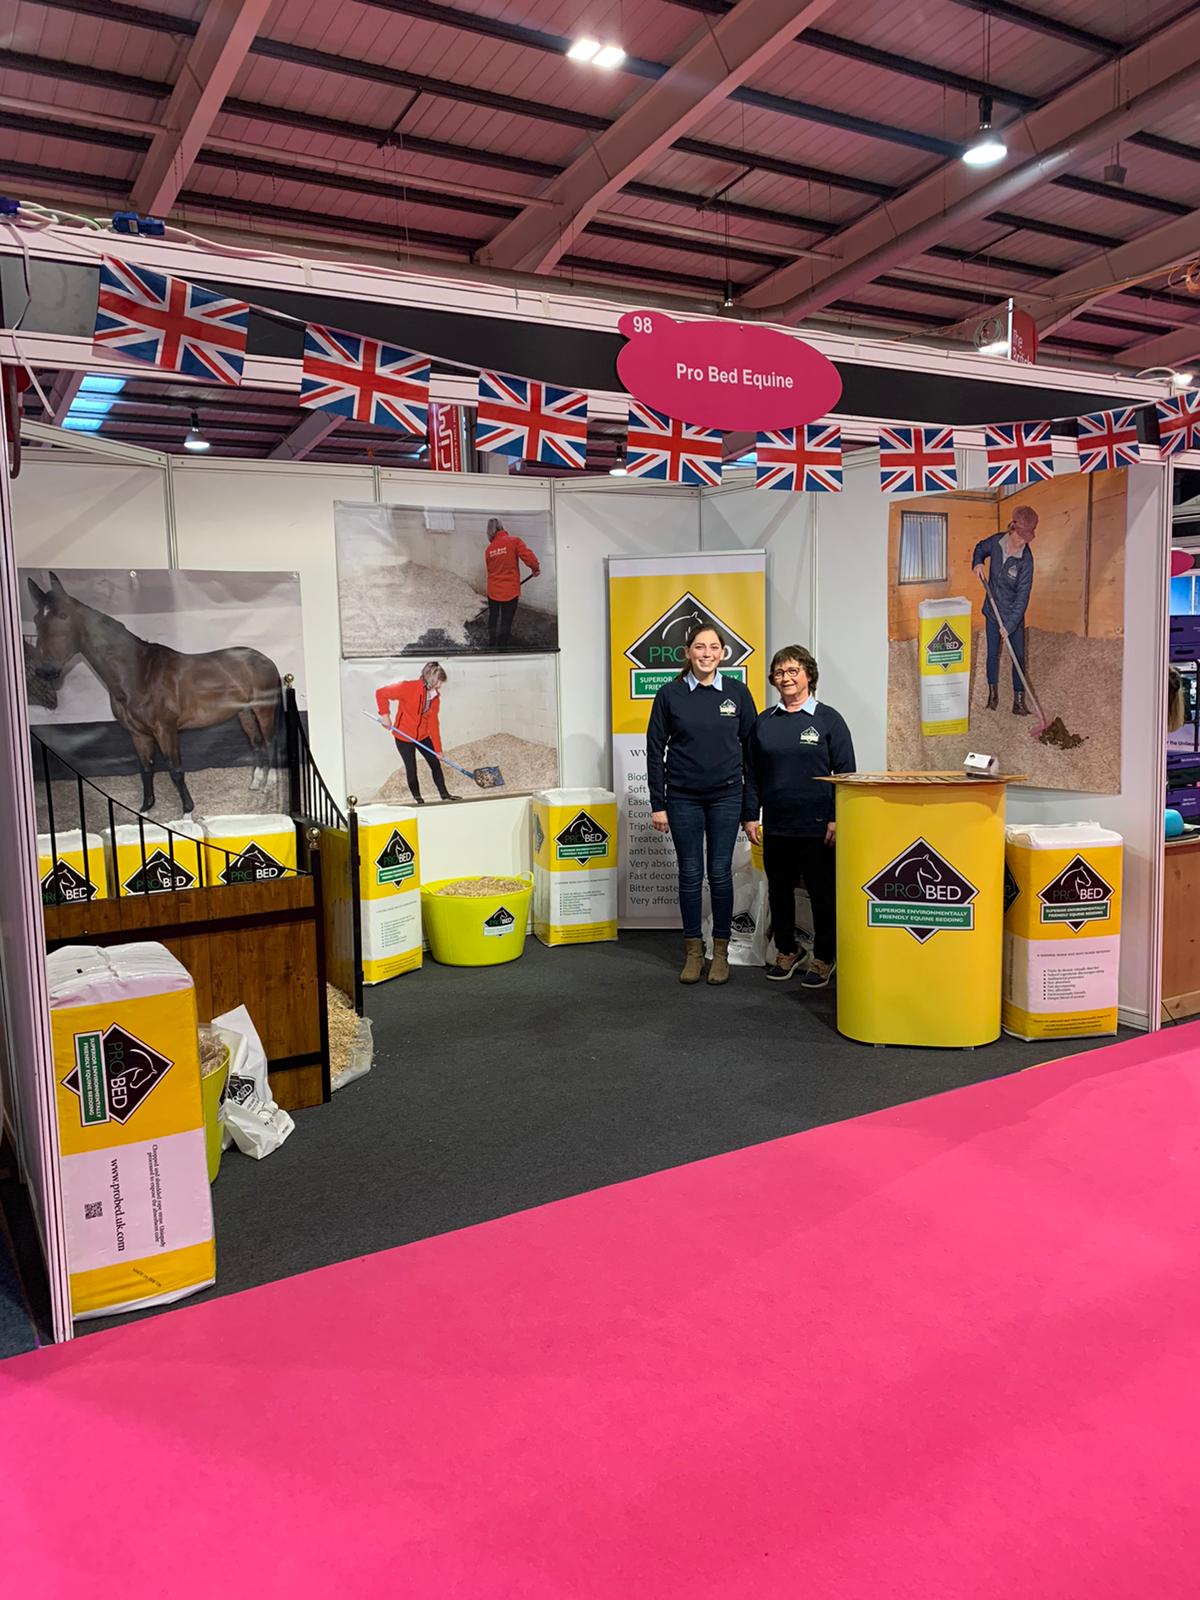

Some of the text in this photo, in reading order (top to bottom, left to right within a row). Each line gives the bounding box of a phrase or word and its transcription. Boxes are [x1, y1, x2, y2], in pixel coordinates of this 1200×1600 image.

[633, 316, 653, 334] 98
[676, 363, 794, 390] Pro Bed Equine
[627, 773, 648, 781] Biod
[628, 785, 647, 794] Soft
[630, 835, 663, 843] Treated
[648, 847, 676, 855] bacter
[630, 859, 678, 869] Very absor
[629, 872, 680, 880] Fast decom
[629, 884, 654, 892] Bitter
[630, 896, 679, 906] Very afford
[907, 909, 968, 917] ENVIRONMENTALLY
[83, 1042, 91, 1068] FRIENDLY
[90, 1038, 98, 1065] SUPERIOR
[110, 1159, 126, 1251] www.probed.uk.com
